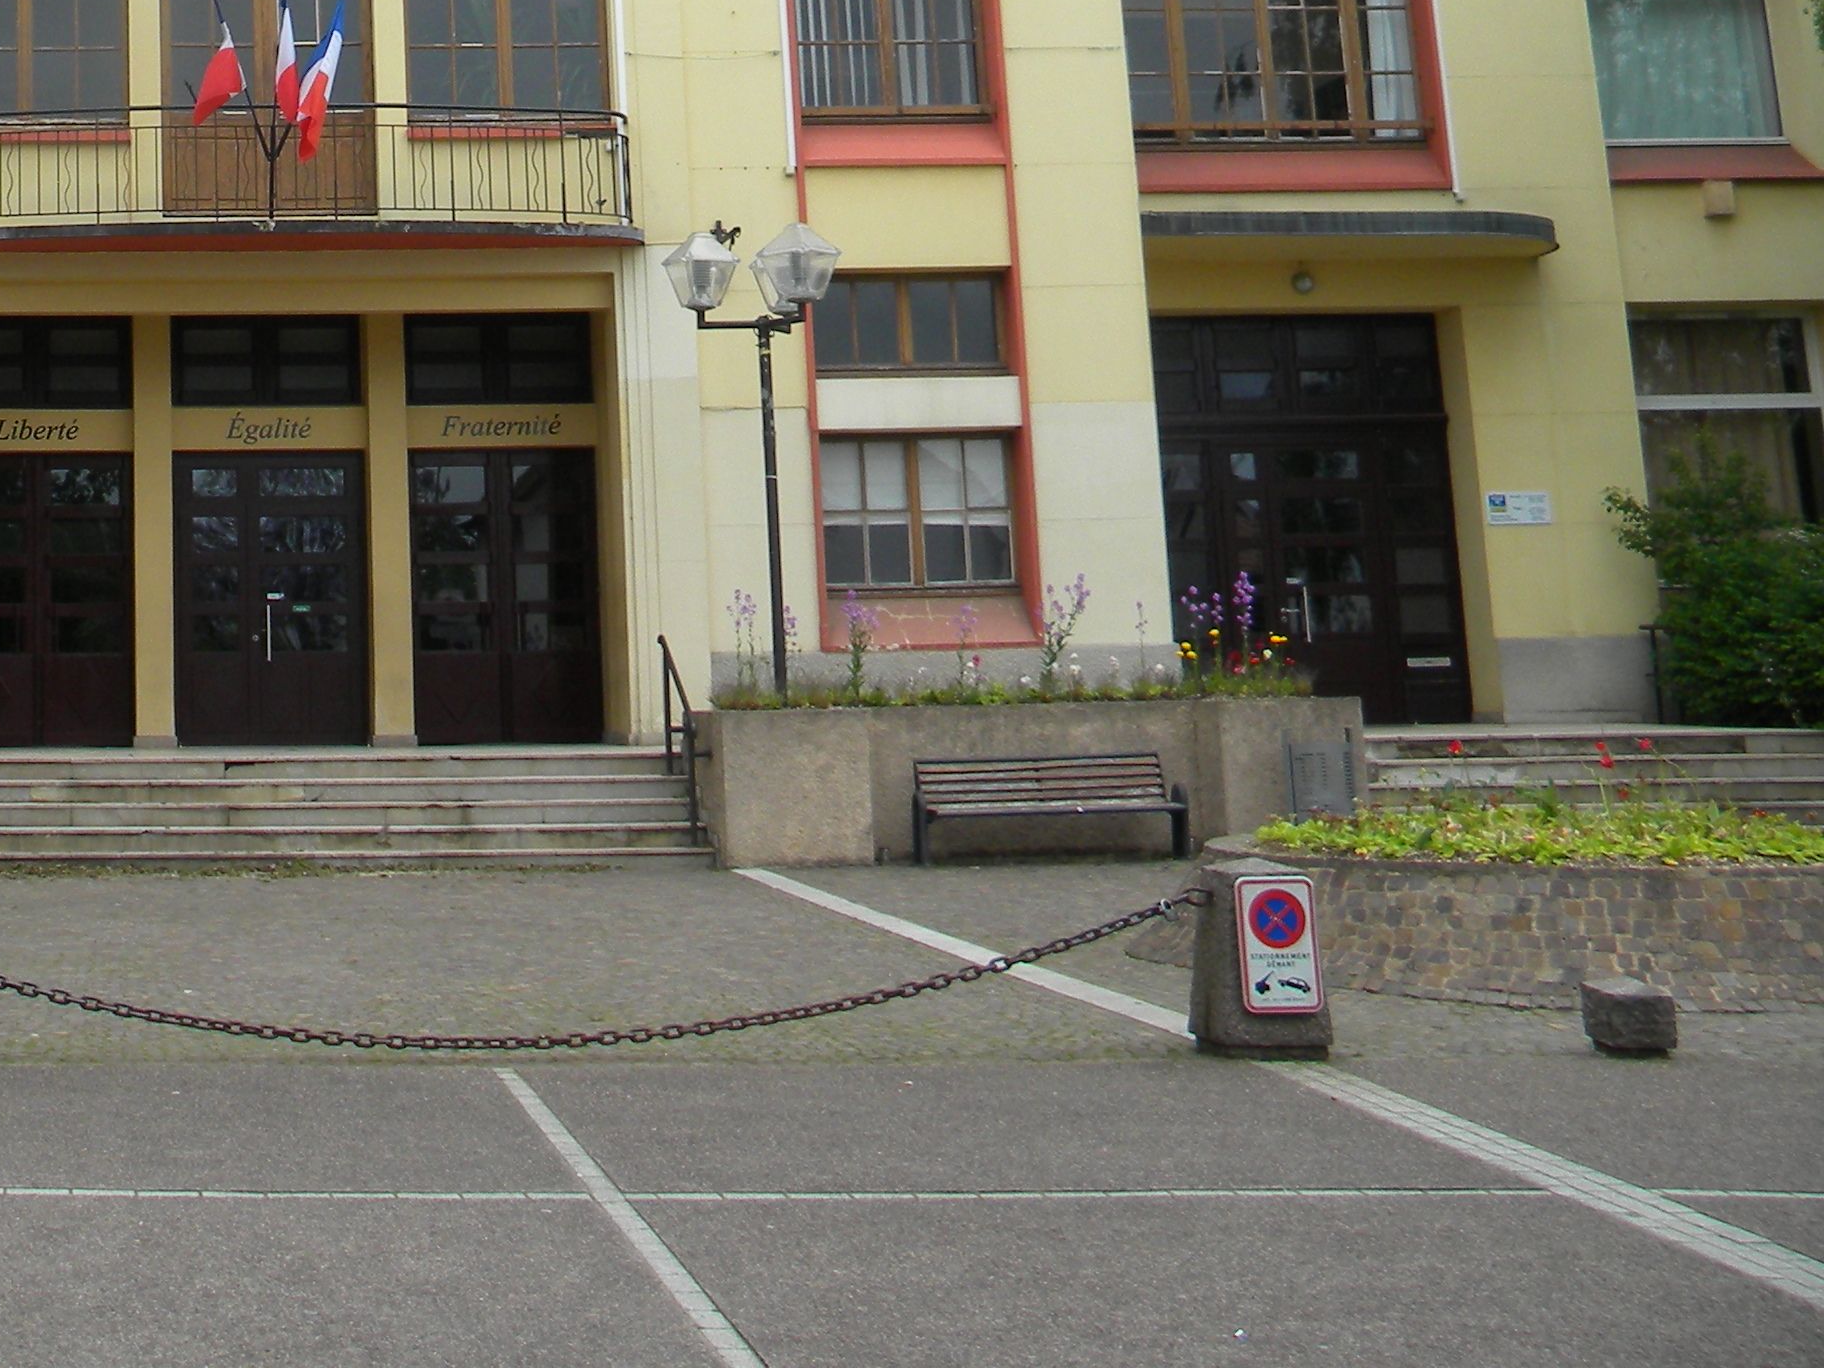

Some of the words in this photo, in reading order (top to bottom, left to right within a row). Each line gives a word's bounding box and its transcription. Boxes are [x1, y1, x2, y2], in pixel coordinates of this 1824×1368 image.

[226, 411, 311, 444] Égalité
[442, 413, 561, 437] Fraternité
[1250, 952, 1311, 960] STATIONNEMENT
